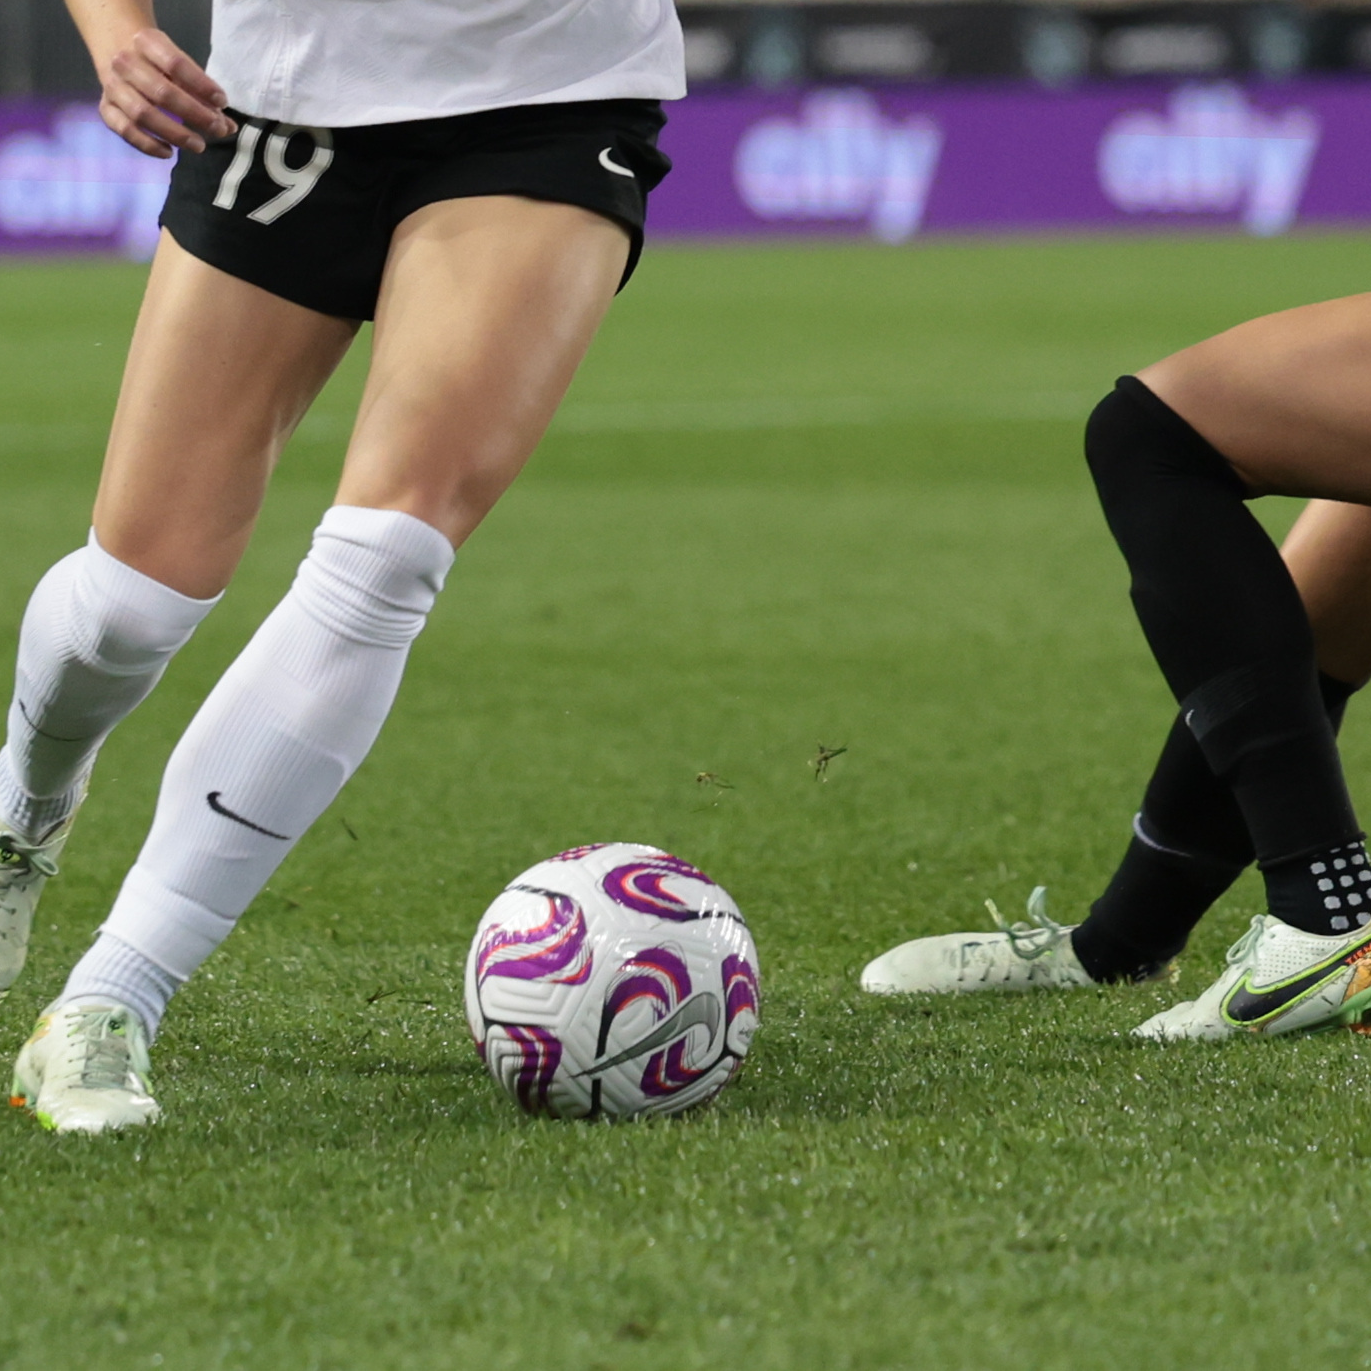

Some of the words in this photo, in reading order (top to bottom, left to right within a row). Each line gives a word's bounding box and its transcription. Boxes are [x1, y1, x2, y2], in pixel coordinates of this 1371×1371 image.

[212, 120, 334, 225] 19
[735, 86, 944, 243] ally
[1098, 80, 1323, 237] ally
